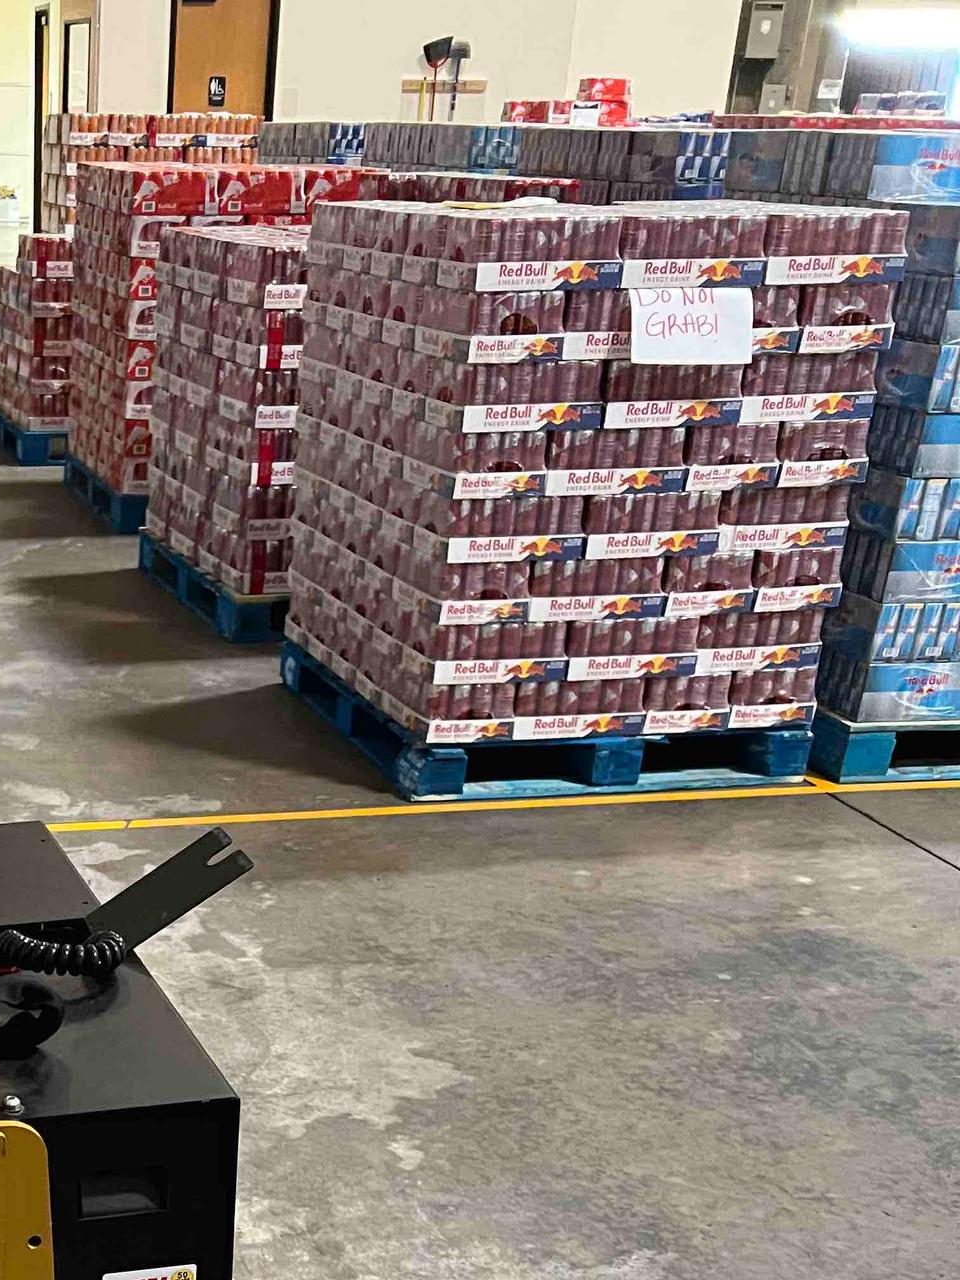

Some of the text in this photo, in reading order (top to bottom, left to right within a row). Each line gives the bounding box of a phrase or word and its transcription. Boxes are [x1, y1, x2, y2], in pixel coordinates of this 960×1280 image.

[499, 262, 548, 277] Red Bull
[644, 261, 692, 275] Red Bull
[789, 257, 835, 272] Red Bull
[611, 332, 631, 346] Bul
[626, 402, 673, 416] Red Bull
[761, 396, 807, 410] Red Bull
[485, 406, 532, 420] Red Bull
[568, 471, 614, 484] Red Bull
